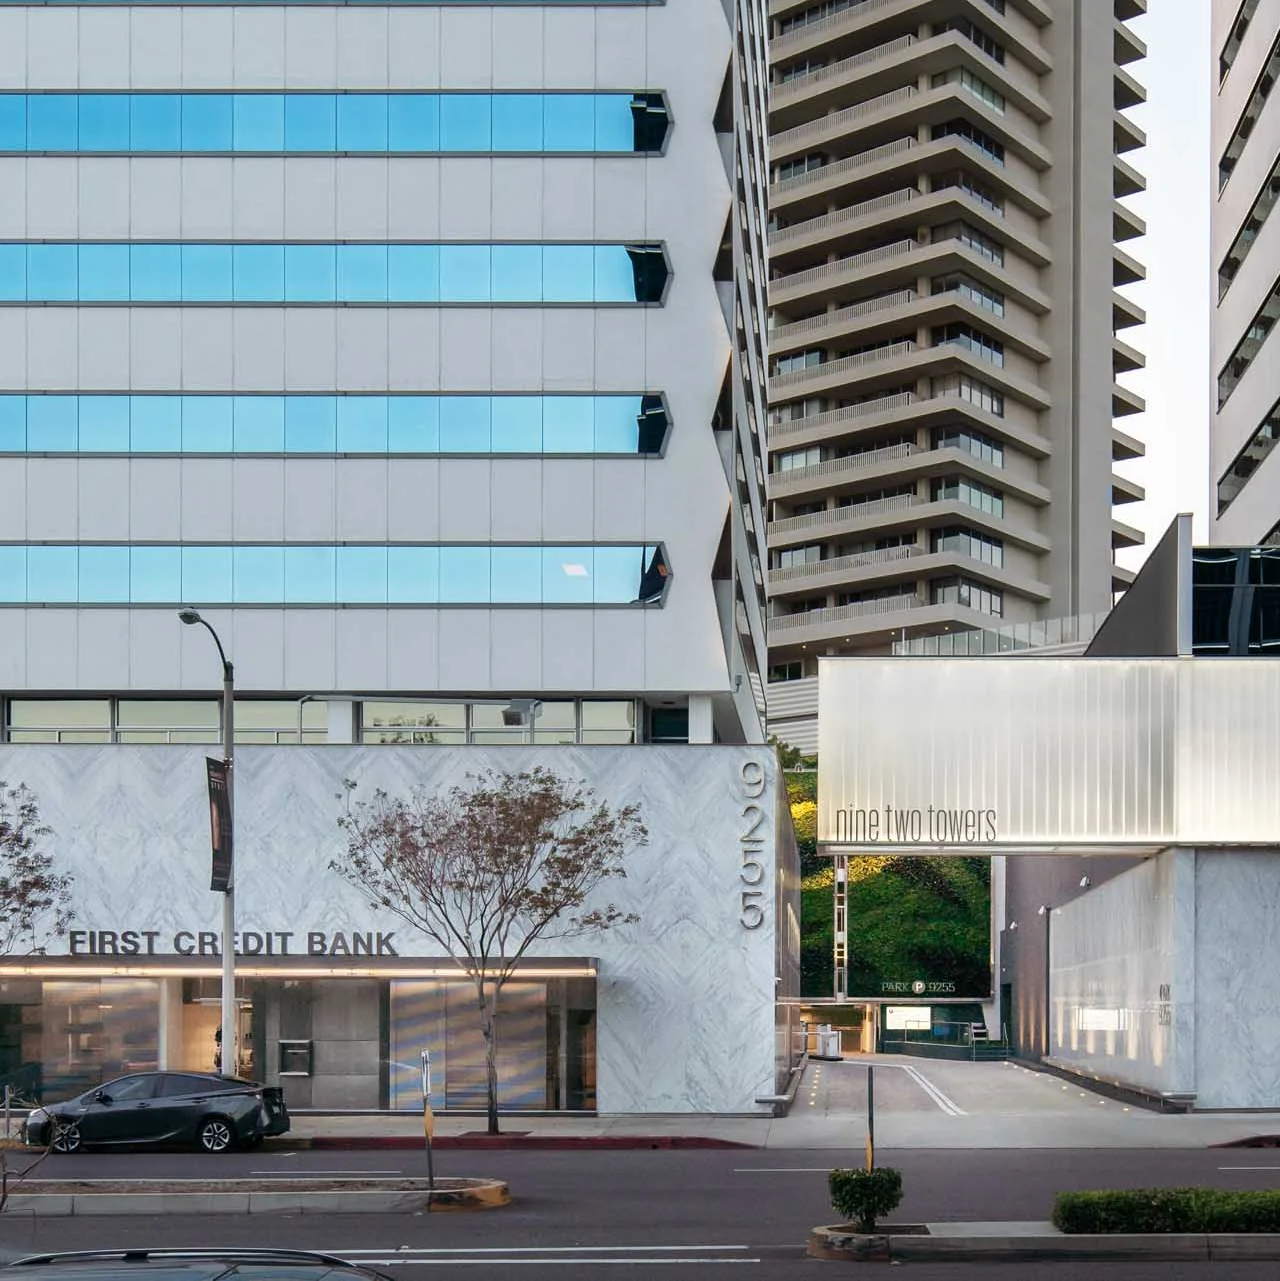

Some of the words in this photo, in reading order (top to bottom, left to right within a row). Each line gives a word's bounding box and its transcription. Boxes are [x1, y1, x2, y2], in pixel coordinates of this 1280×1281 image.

[836, 804, 879, 842] nine
[885, 804, 921, 842] two
[927, 804, 997, 842] towers
[70, 930, 160, 956] FIRST
[307, 931, 399, 957] BANK
[882, 982, 909, 992] PARK
[928, 982, 956, 992] 9255
